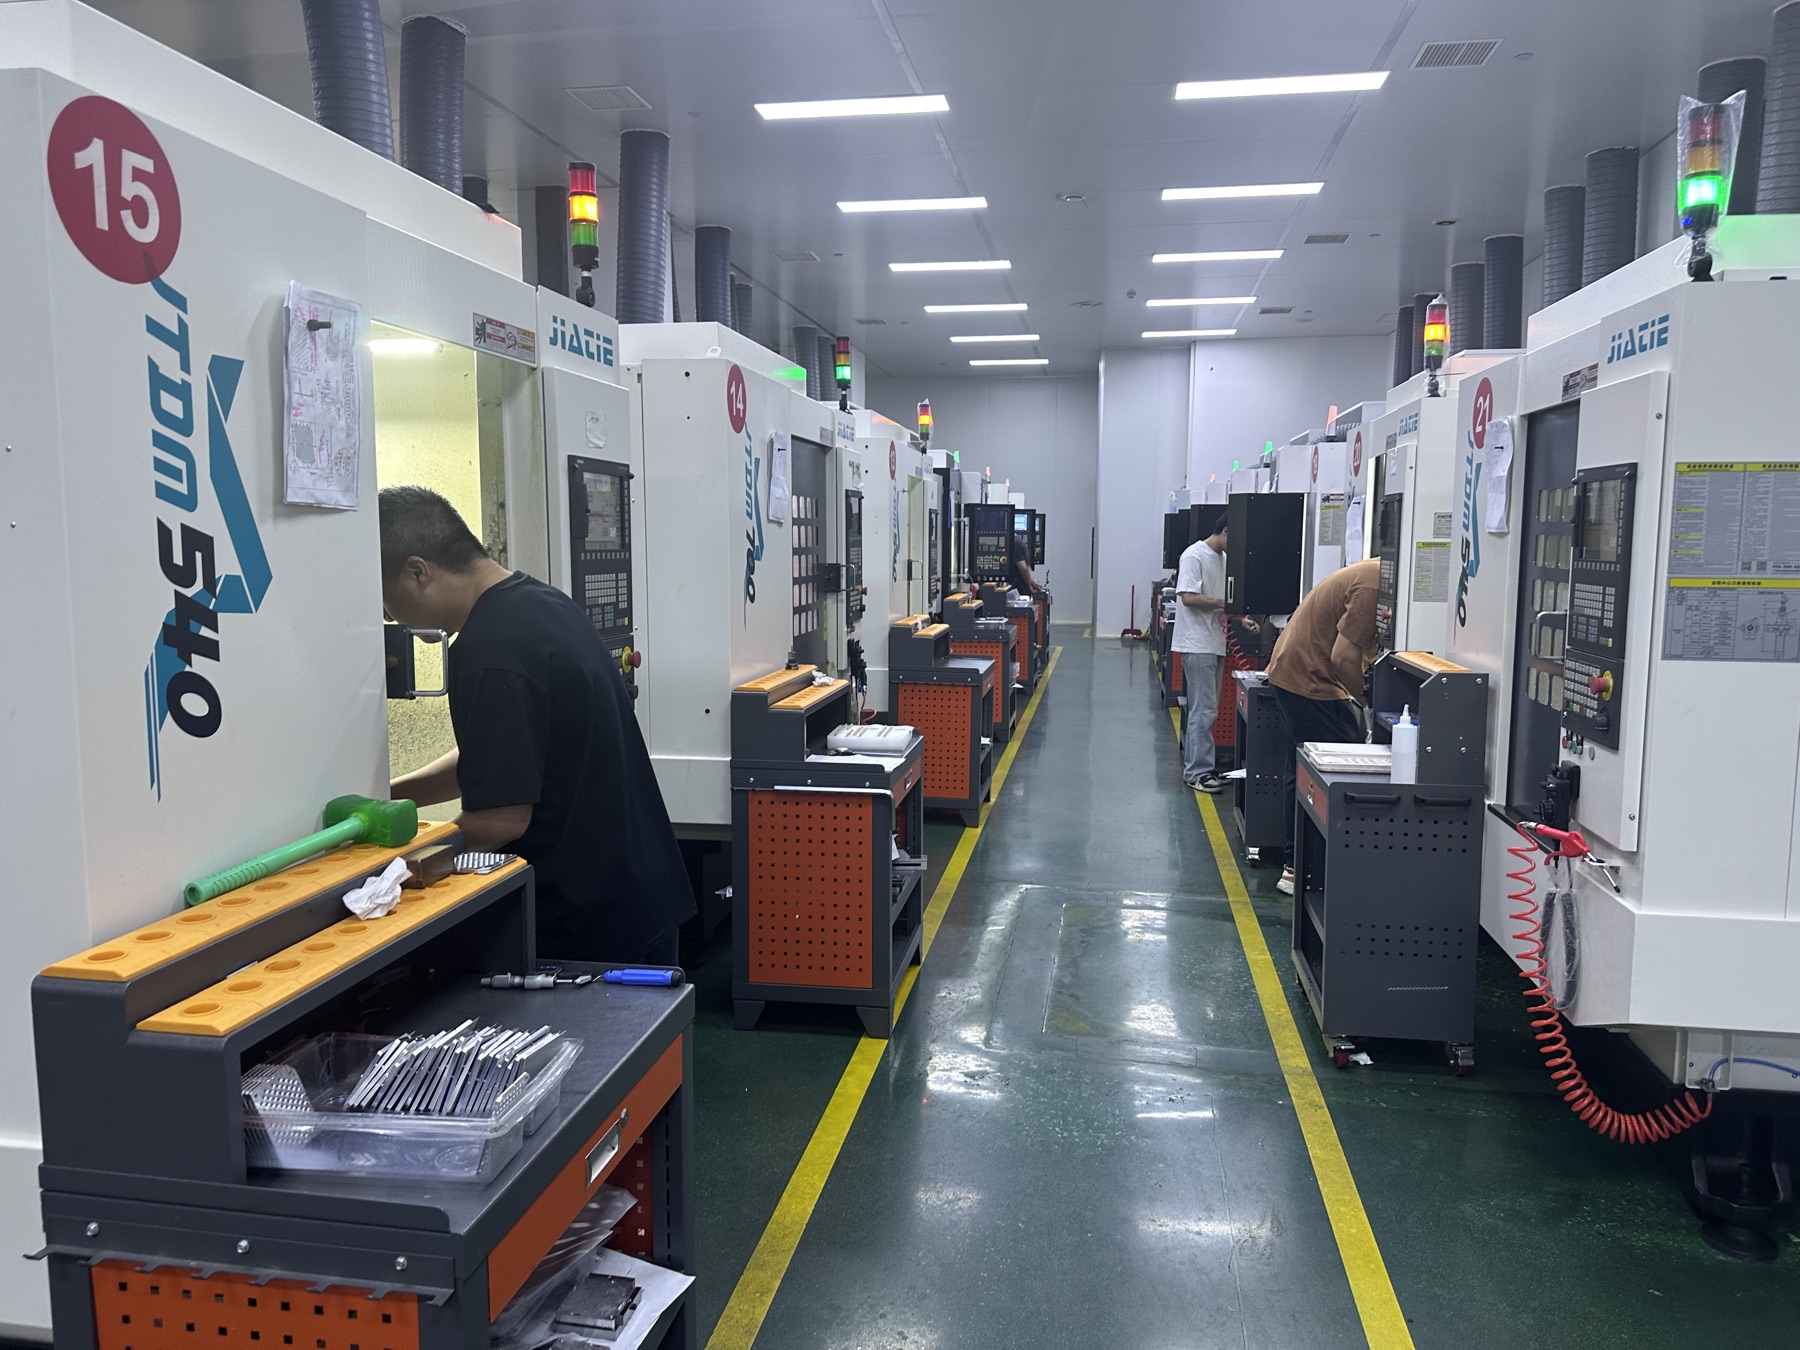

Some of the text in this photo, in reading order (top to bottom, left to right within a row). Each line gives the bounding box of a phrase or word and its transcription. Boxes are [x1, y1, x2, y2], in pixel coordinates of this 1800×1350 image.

[74, 137, 160, 243] 15
[730, 381, 744, 417] 14
[1476, 393, 1490, 433] 21
[1353, 441, 1361, 467] 20
[746, 526, 756, 604] 700
[1458, 535, 1471, 628] 540
[157, 517, 222, 738] 540
